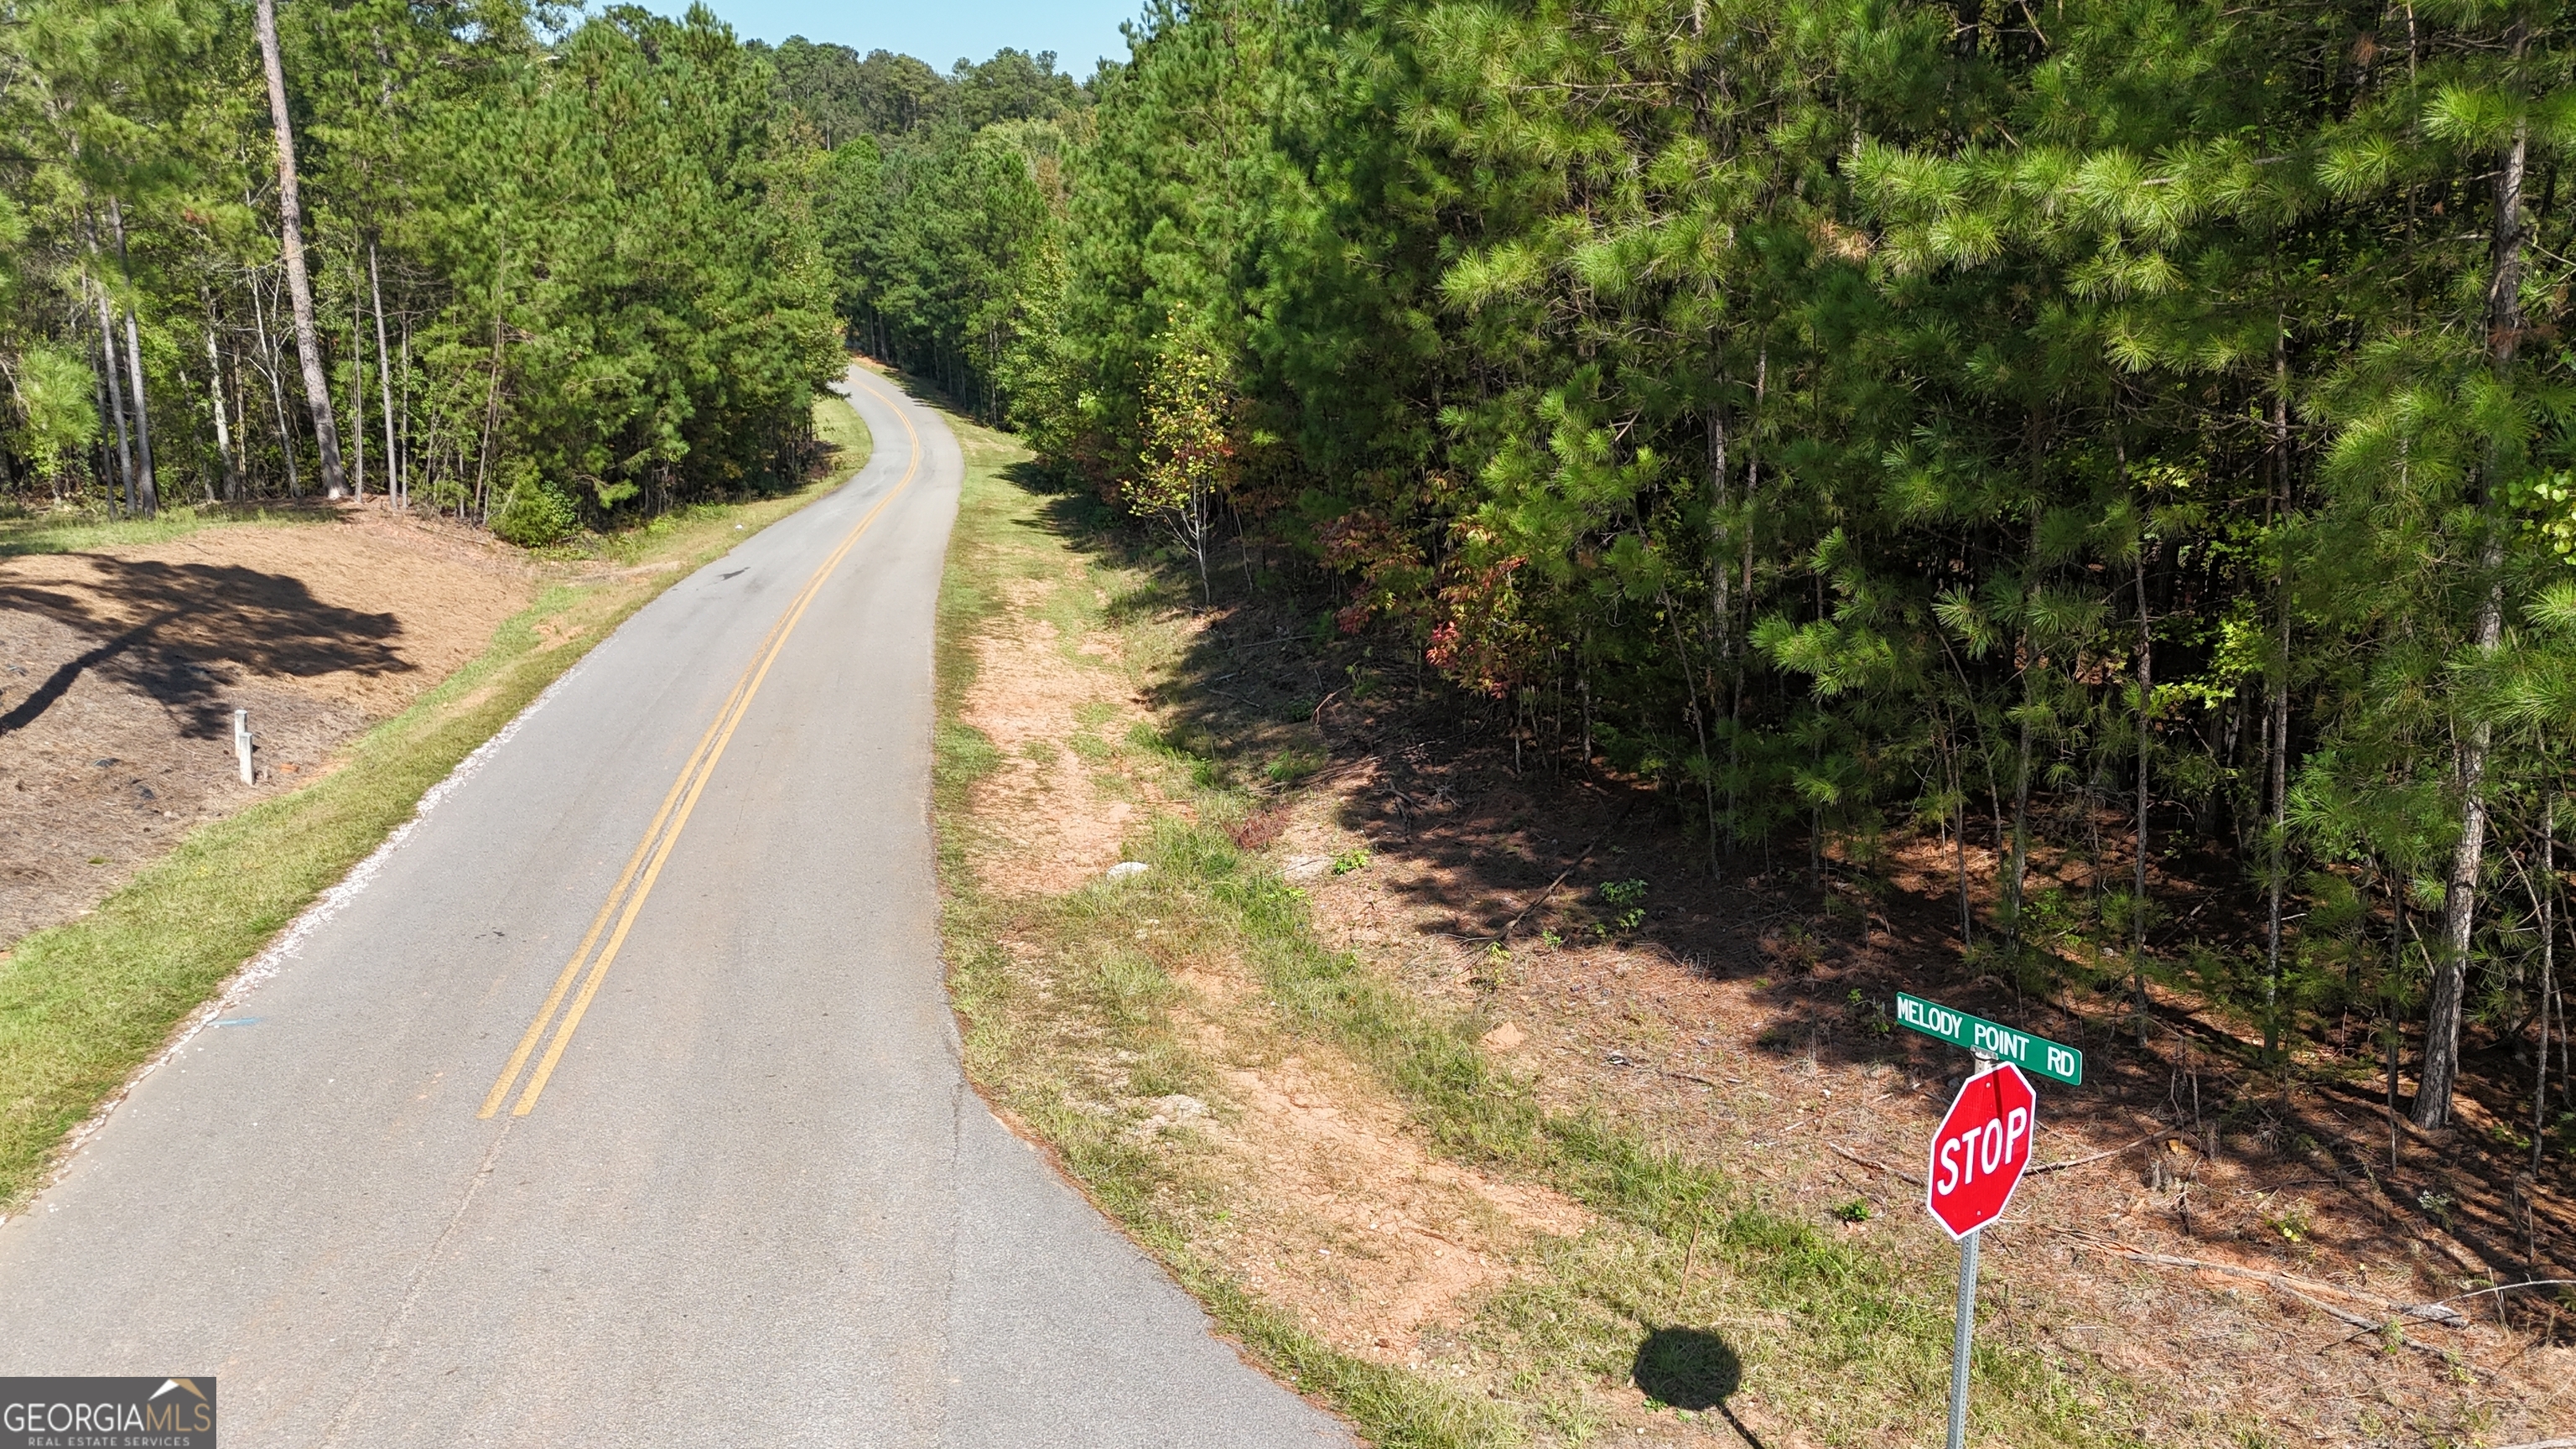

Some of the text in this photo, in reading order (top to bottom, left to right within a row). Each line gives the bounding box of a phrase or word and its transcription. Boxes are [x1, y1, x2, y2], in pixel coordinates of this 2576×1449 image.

[1897, 996, 2075, 1078] MELODY POINT RD
[1936, 1106, 2027, 1196] STOP
